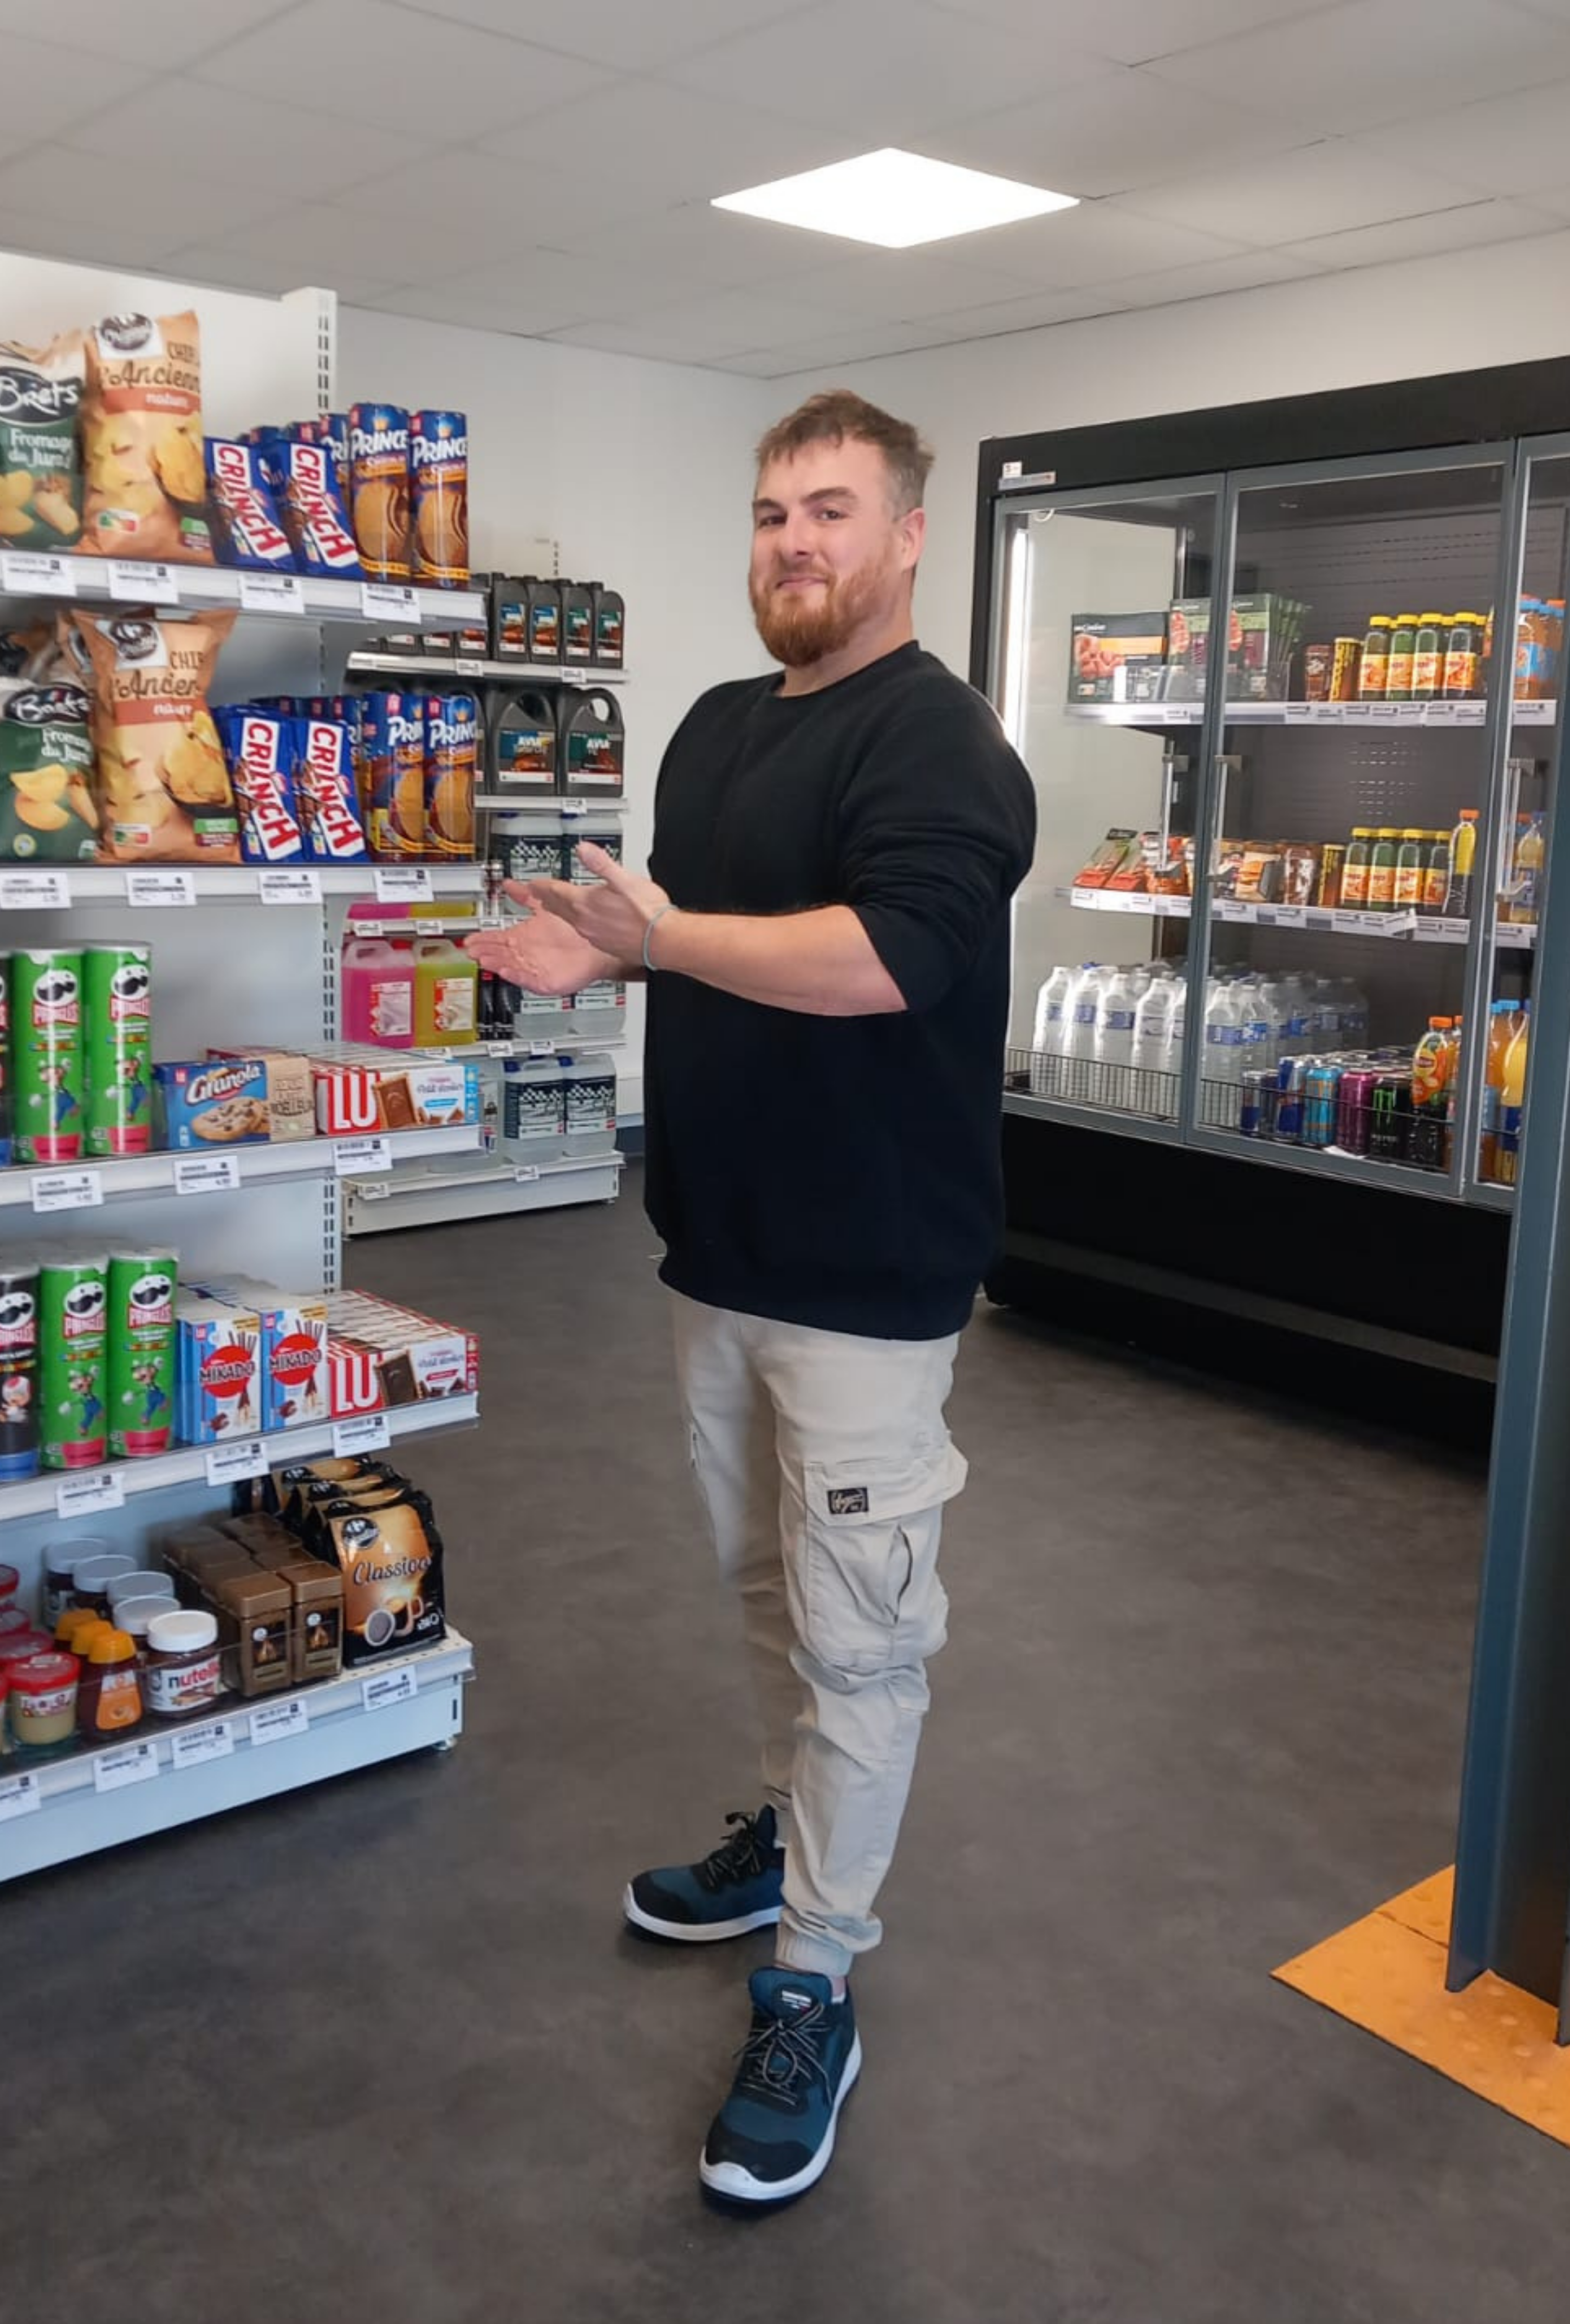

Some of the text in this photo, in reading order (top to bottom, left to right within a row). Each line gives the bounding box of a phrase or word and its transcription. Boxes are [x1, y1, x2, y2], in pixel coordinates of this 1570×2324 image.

[218, 446, 287, 551] CRUNCH
[295, 448, 356, 558] CRUNCH
[246, 723, 299, 849] CRUNCH
[312, 728, 363, 849] CRUNCH
[187, 1064, 260, 1103] Granola
[333, 1070, 377, 1129] LU
[199, 1361, 255, 1383] MIKADO
[270, 1349, 321, 1373] MIKADO
[338, 1354, 377, 1412] LU
